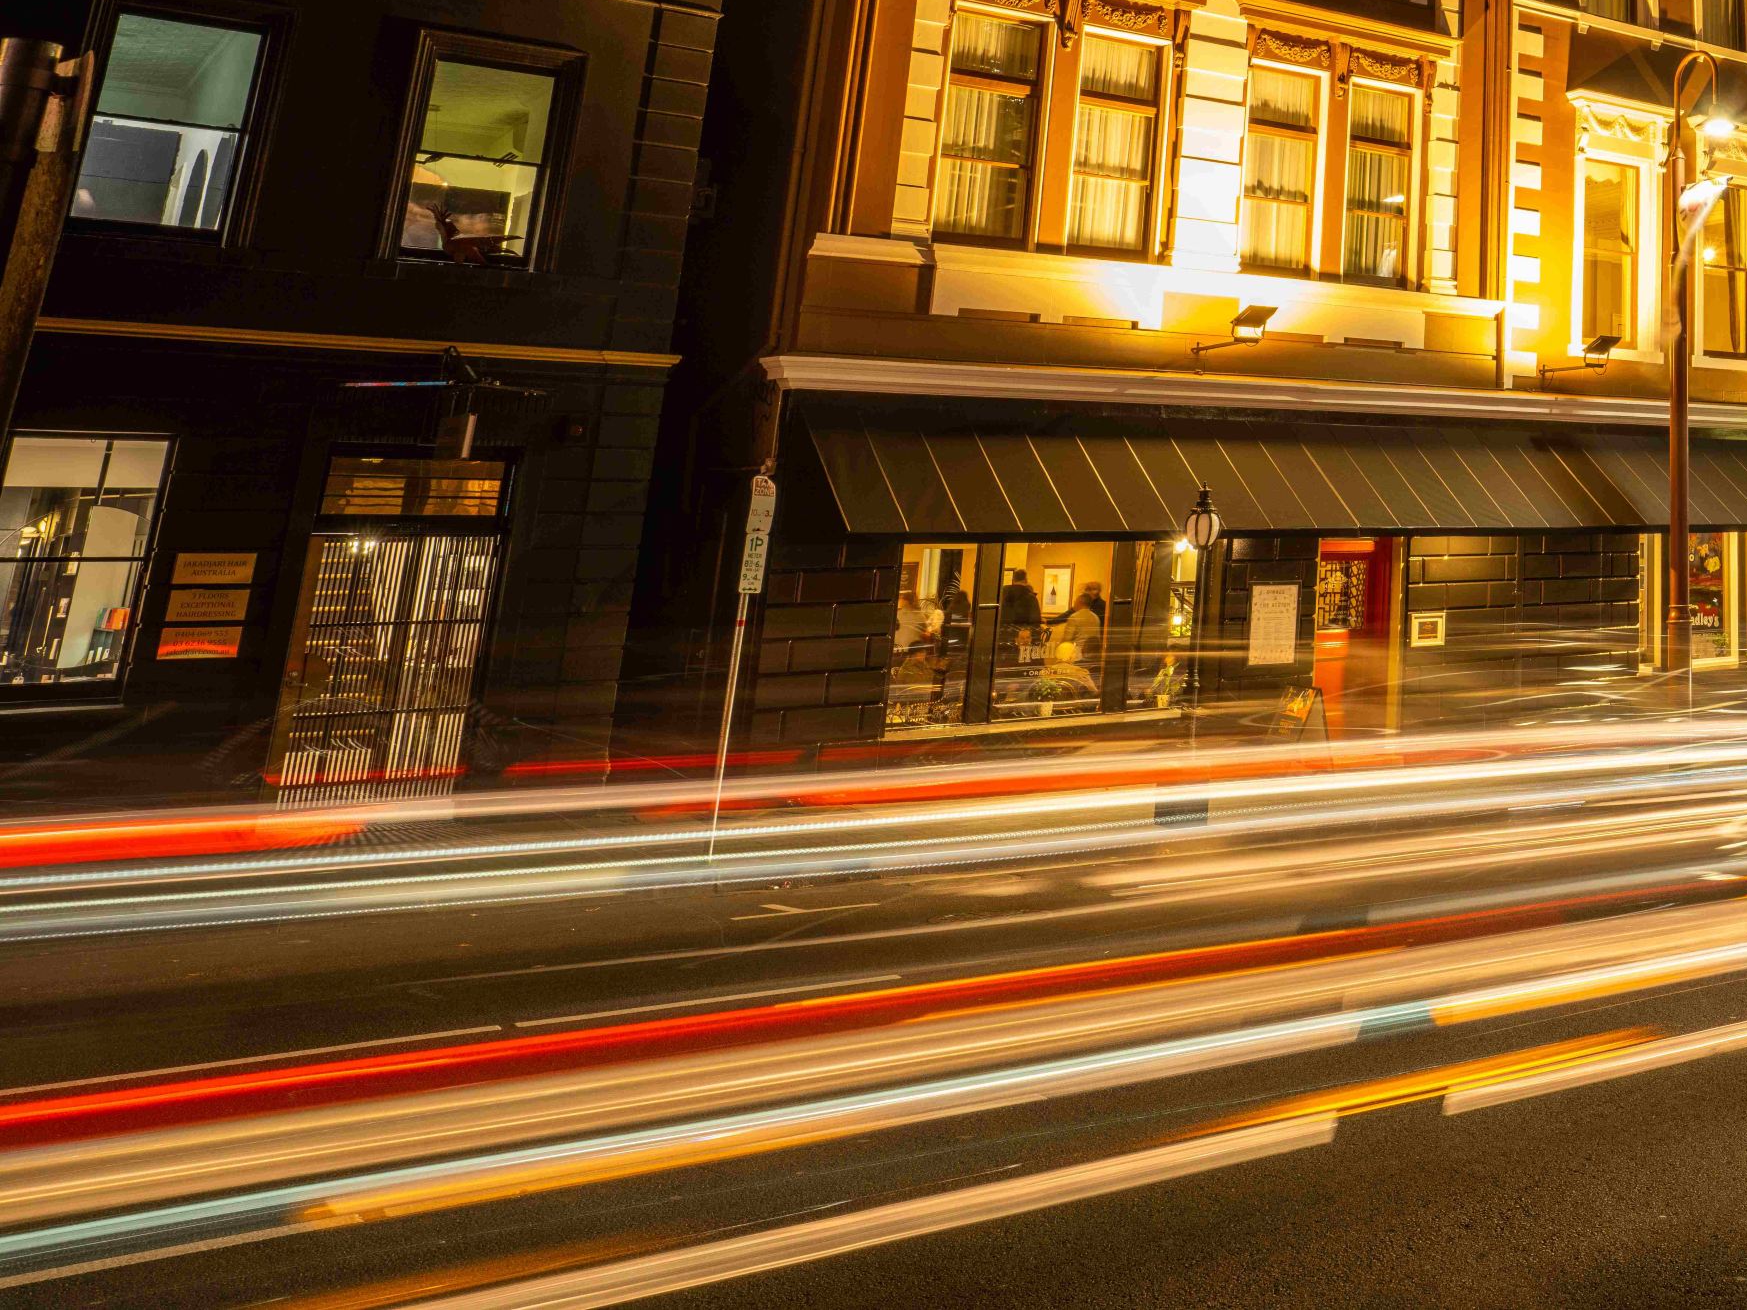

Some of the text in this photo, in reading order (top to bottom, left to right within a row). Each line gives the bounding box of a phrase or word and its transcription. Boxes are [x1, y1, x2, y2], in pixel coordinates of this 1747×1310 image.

[754, 487, 775, 496] ZONE
[749, 536, 764, 552] 1P
[191, 569, 236, 577] AUSTRALIA
[180, 601, 235, 609] EXCEPTIONAL
[176, 610, 237, 618] HAIRDRESSING
[1690, 612, 1719, 628] adley's
